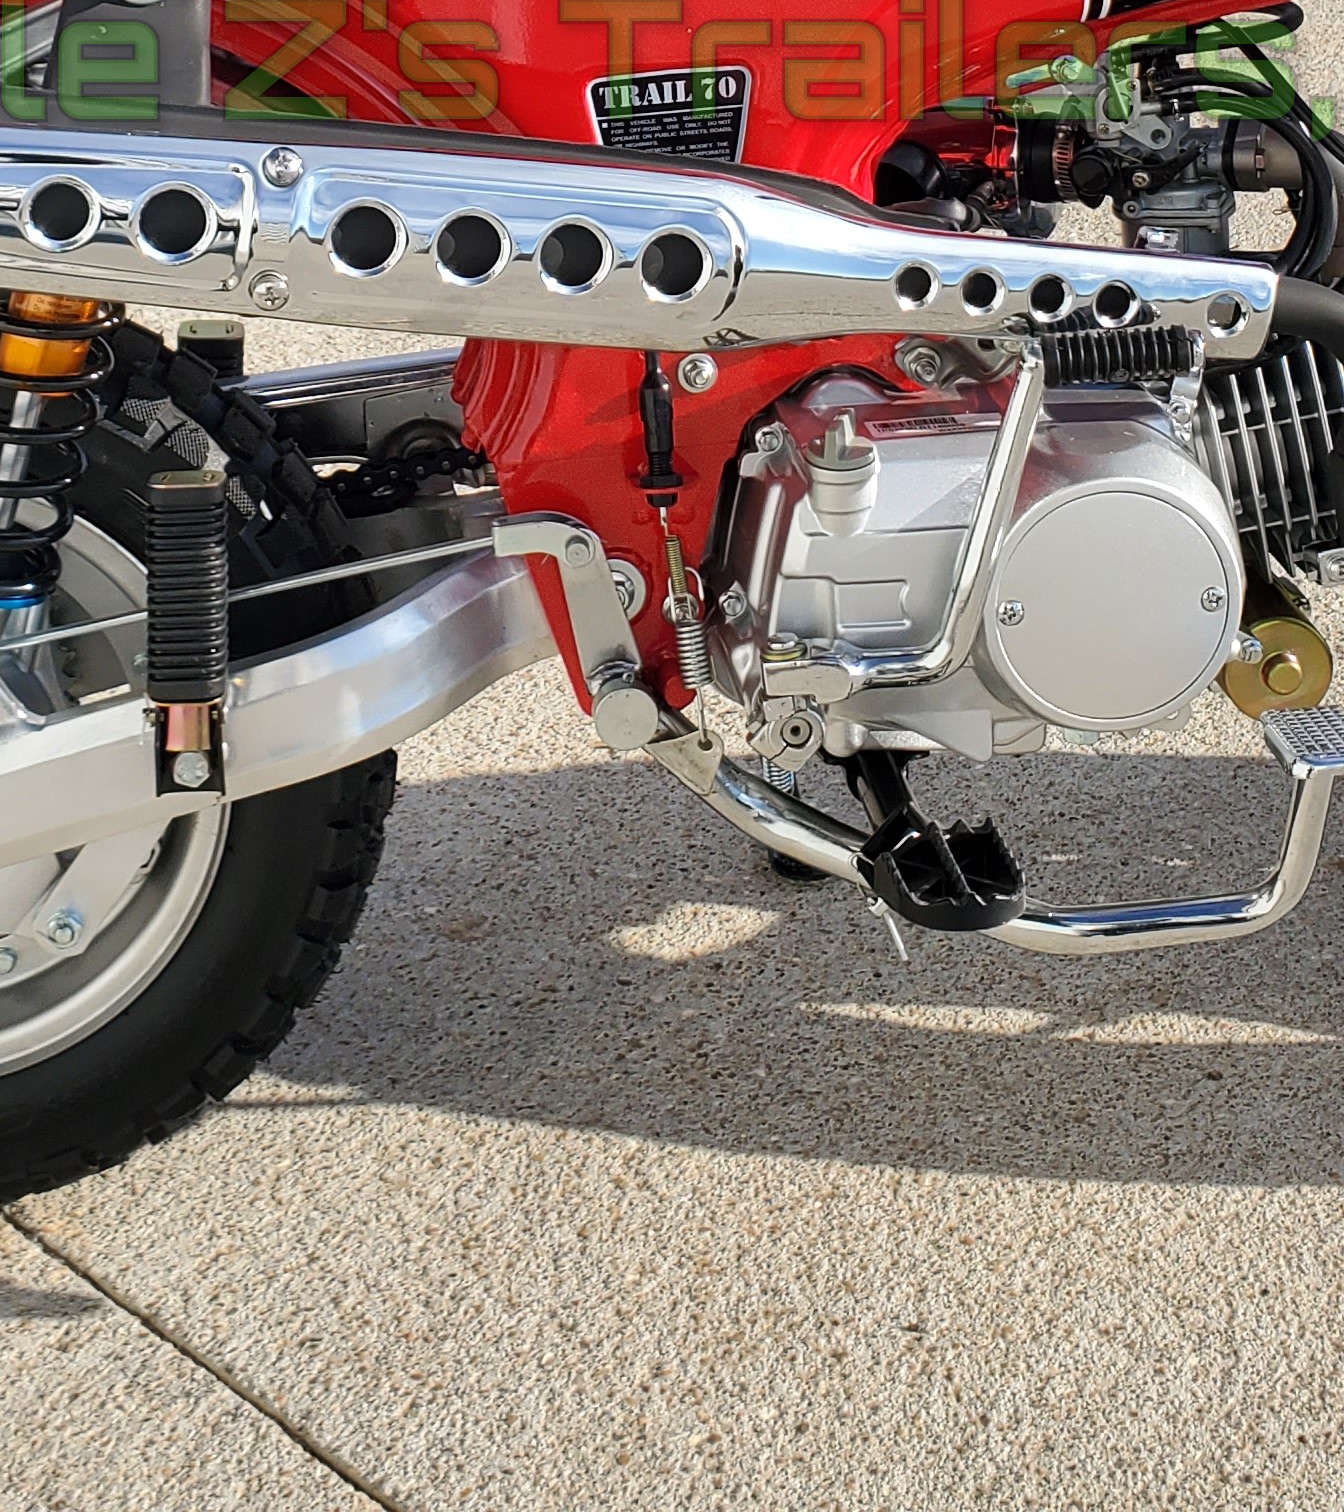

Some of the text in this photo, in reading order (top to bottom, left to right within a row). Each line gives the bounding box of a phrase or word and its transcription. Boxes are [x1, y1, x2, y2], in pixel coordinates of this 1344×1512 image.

[599, 75, 737, 109] TRAIL 70
[629, 118, 656, 126] VEHICLE
[682, 111, 734, 121] MANUFACTURED
[611, 134, 641, 142] OPERATE
[654, 130, 677, 139] PUBLIC
[689, 142, 713, 150] MODIFY
